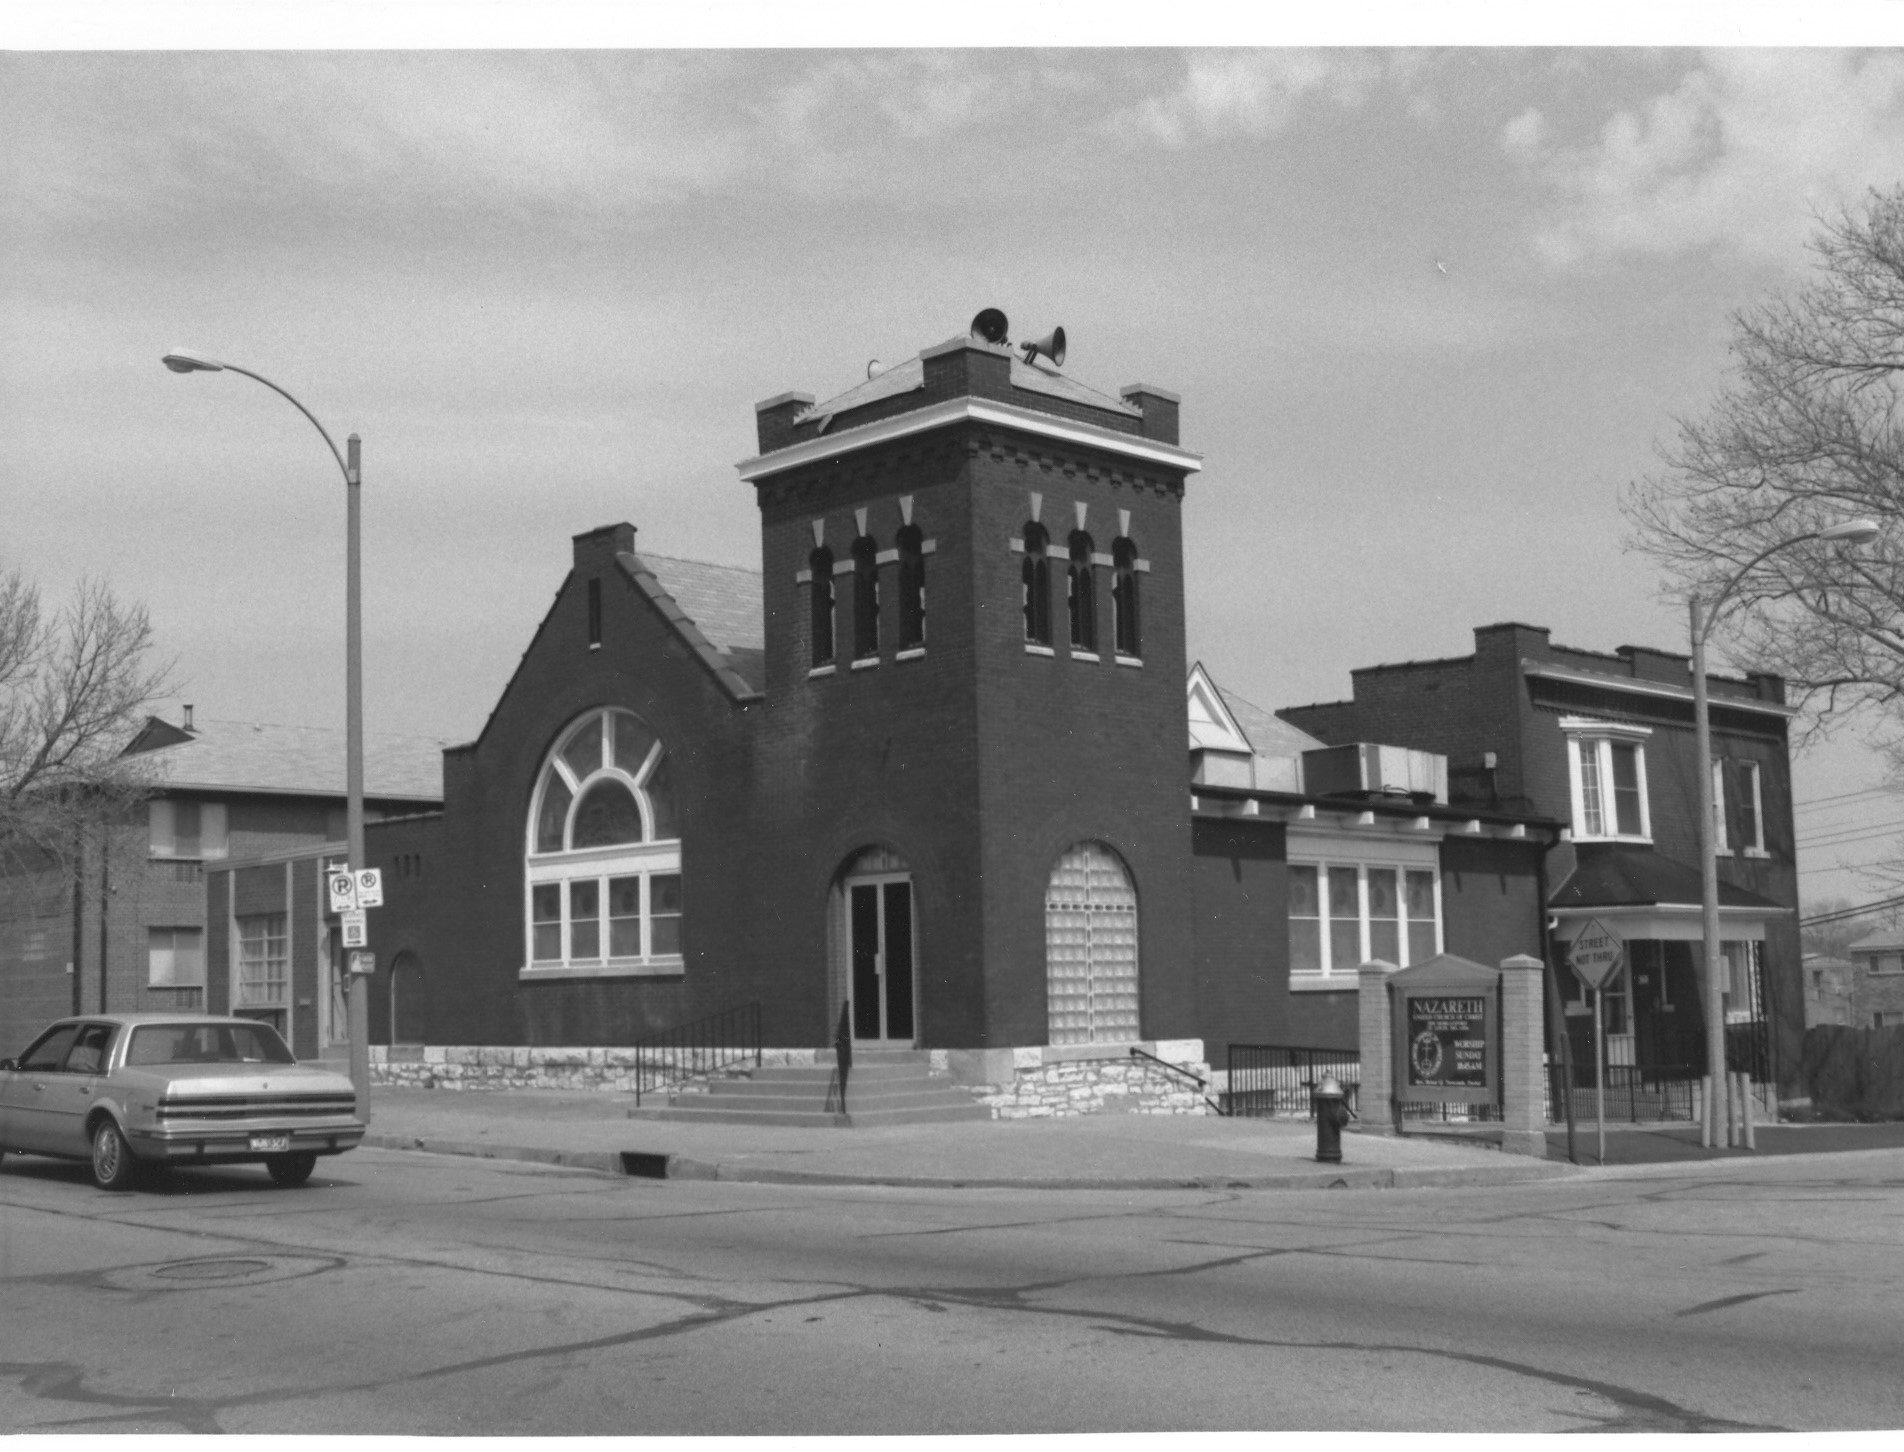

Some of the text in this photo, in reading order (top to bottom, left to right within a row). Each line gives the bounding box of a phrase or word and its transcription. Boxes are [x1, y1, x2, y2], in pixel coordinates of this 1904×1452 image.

[1579, 936, 1609, 950] STREET
[1576, 951, 1613, 965] NOT THRU
[1413, 1000, 1483, 1013] NAZARETH
[1454, 1040, 1485, 1048] WORSHIP
[1455, 1050, 1481, 1060] SUNDAY
